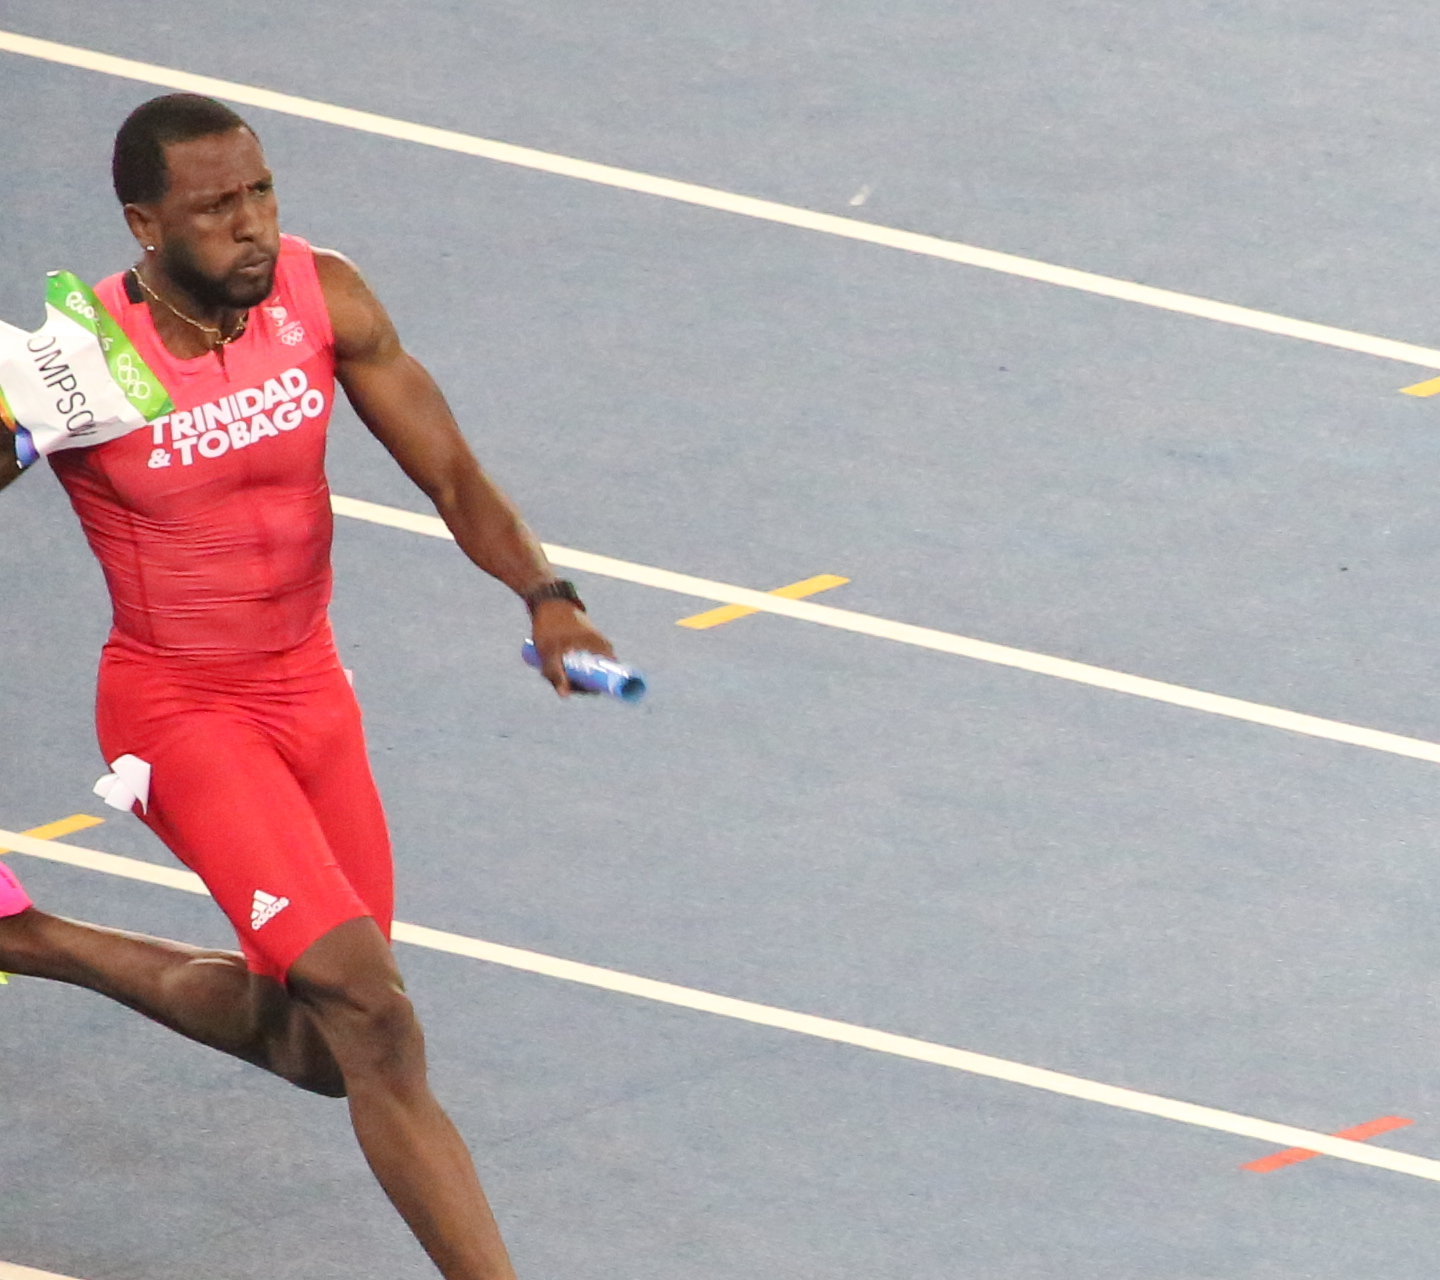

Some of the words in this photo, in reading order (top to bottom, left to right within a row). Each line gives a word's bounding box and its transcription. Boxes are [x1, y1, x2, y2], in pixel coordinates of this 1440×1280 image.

[147, 448, 171, 469] &
[172, 389, 325, 466] TOBAGO
[151, 368, 308, 445] TRINIDAD
[251, 896, 290, 931] adidas
